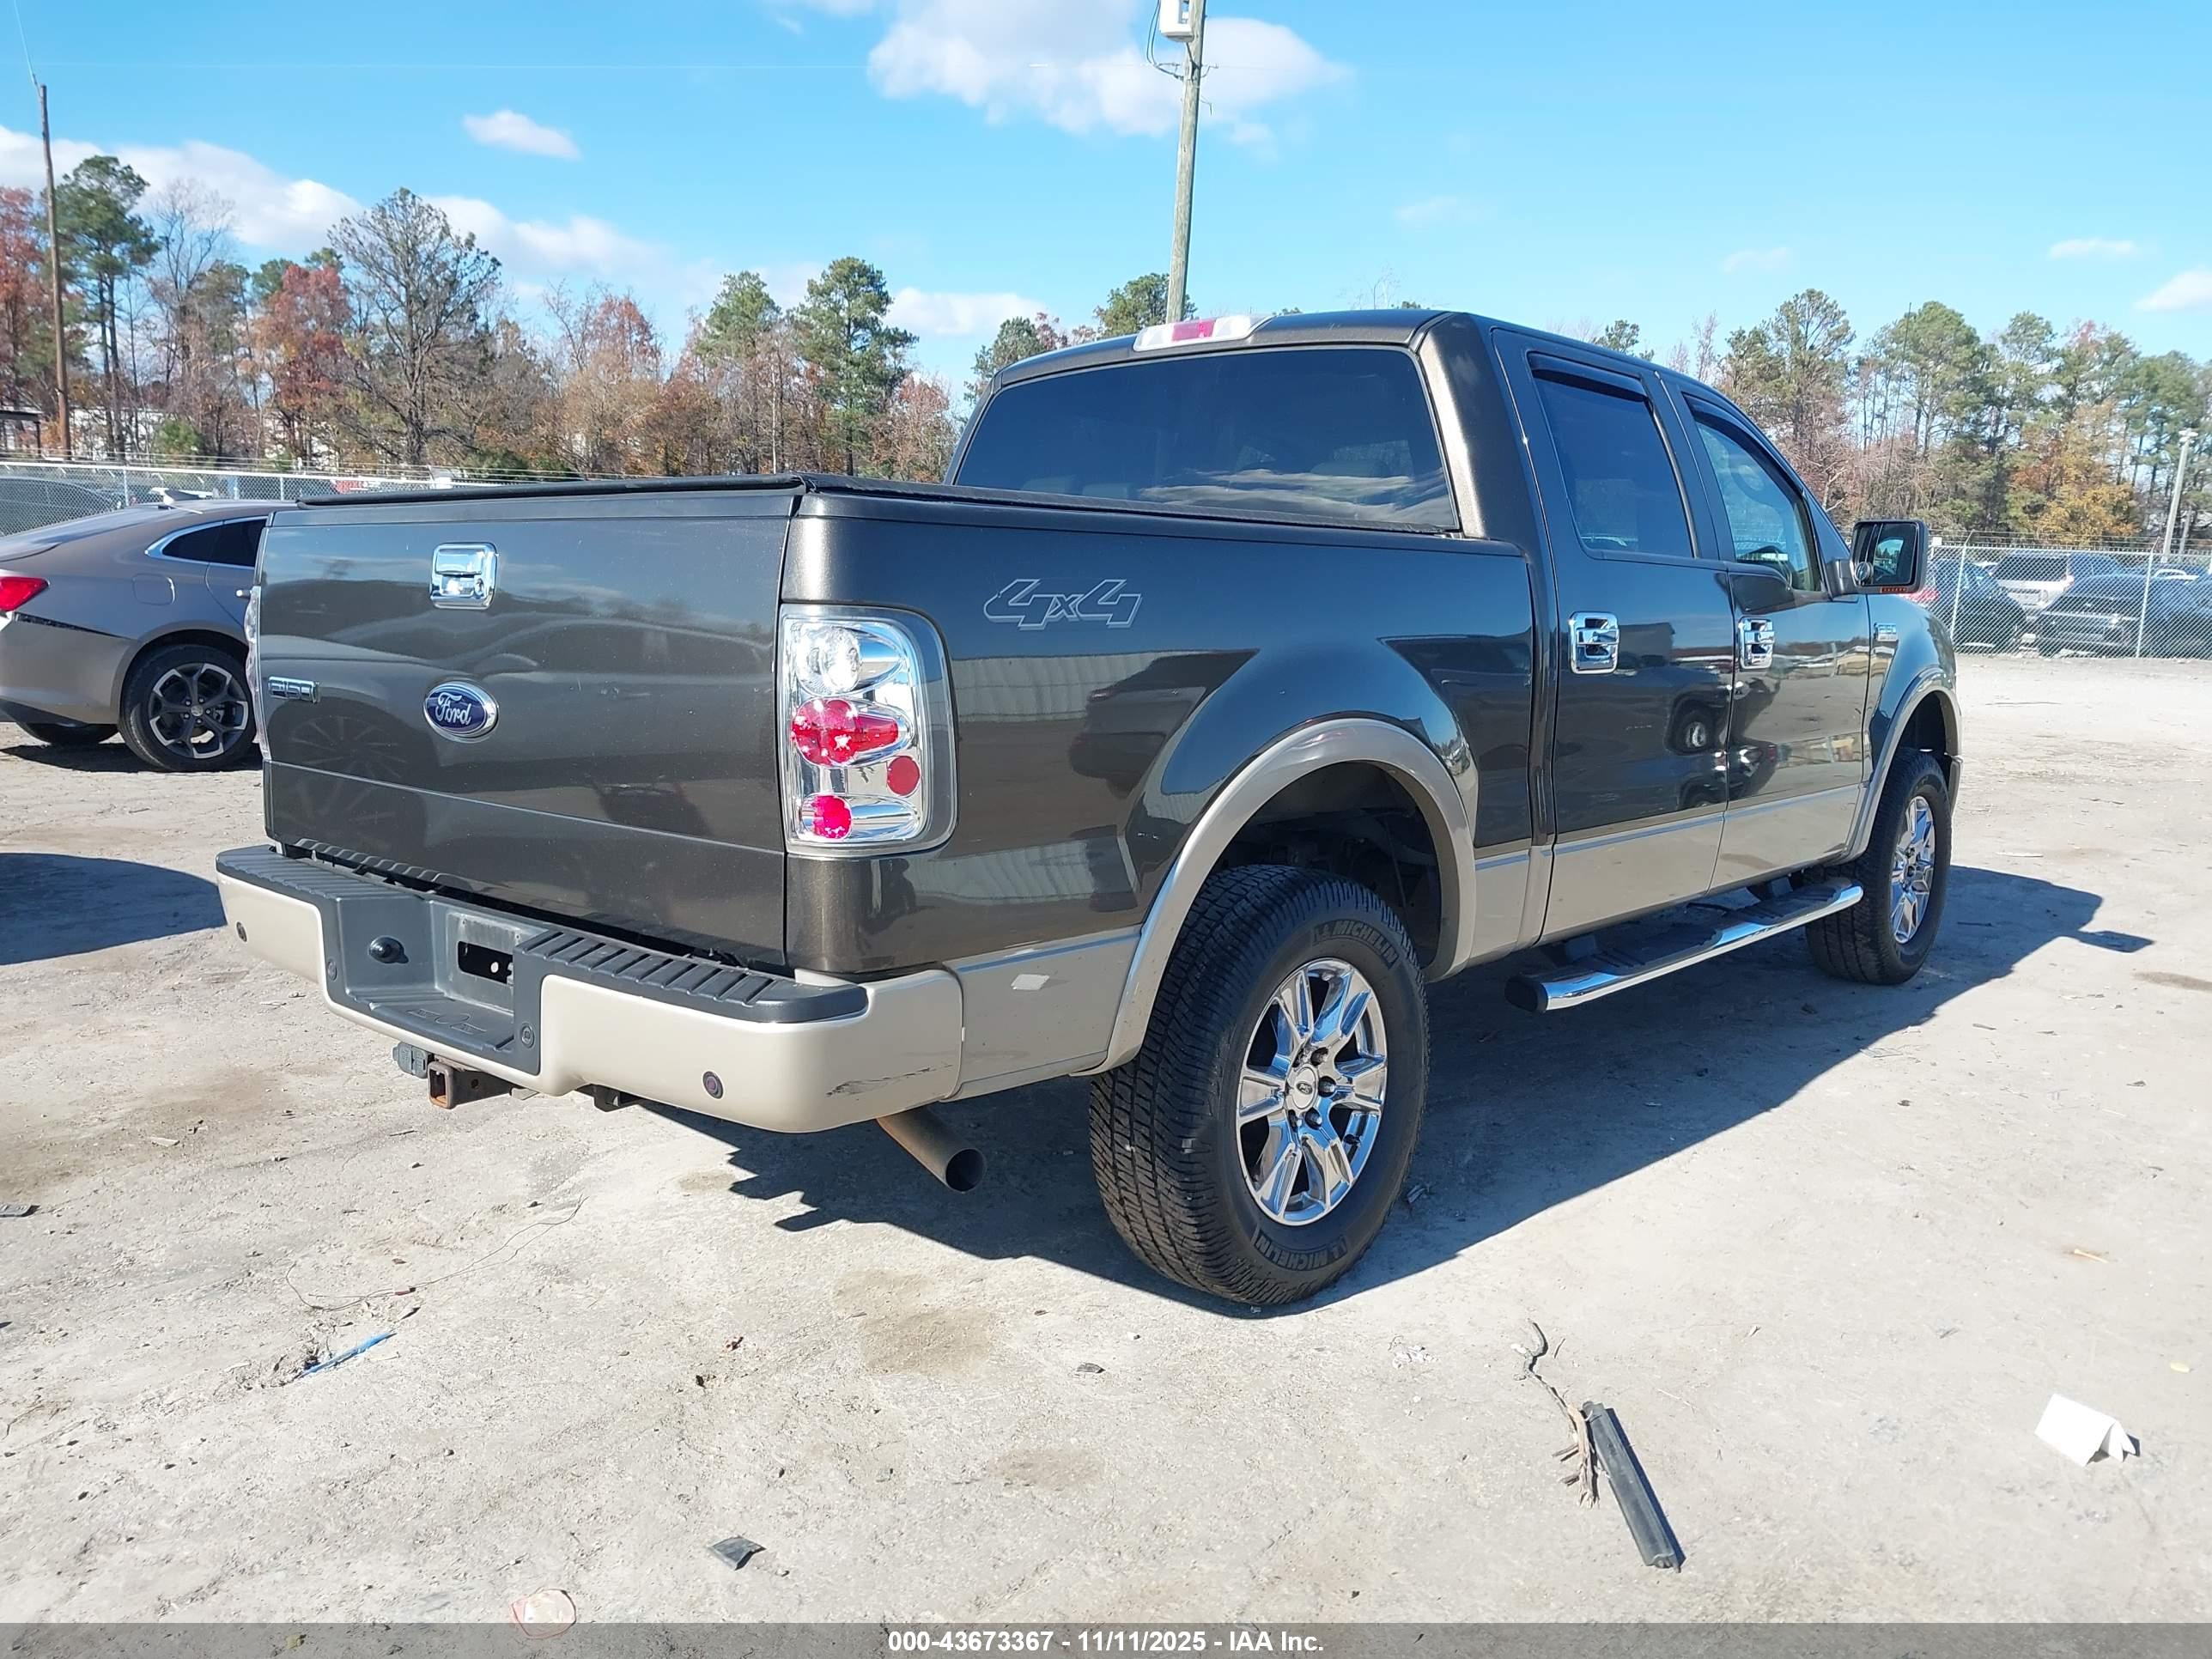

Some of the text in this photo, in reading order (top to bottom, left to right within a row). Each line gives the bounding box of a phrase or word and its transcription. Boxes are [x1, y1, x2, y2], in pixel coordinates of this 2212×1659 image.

[983, 579, 1142, 629] 4x4
[434, 691, 472, 726] Ford
[1332, 920, 1400, 963] MICHELIN
[1255, 1233, 1328, 1271] MICHELIN
